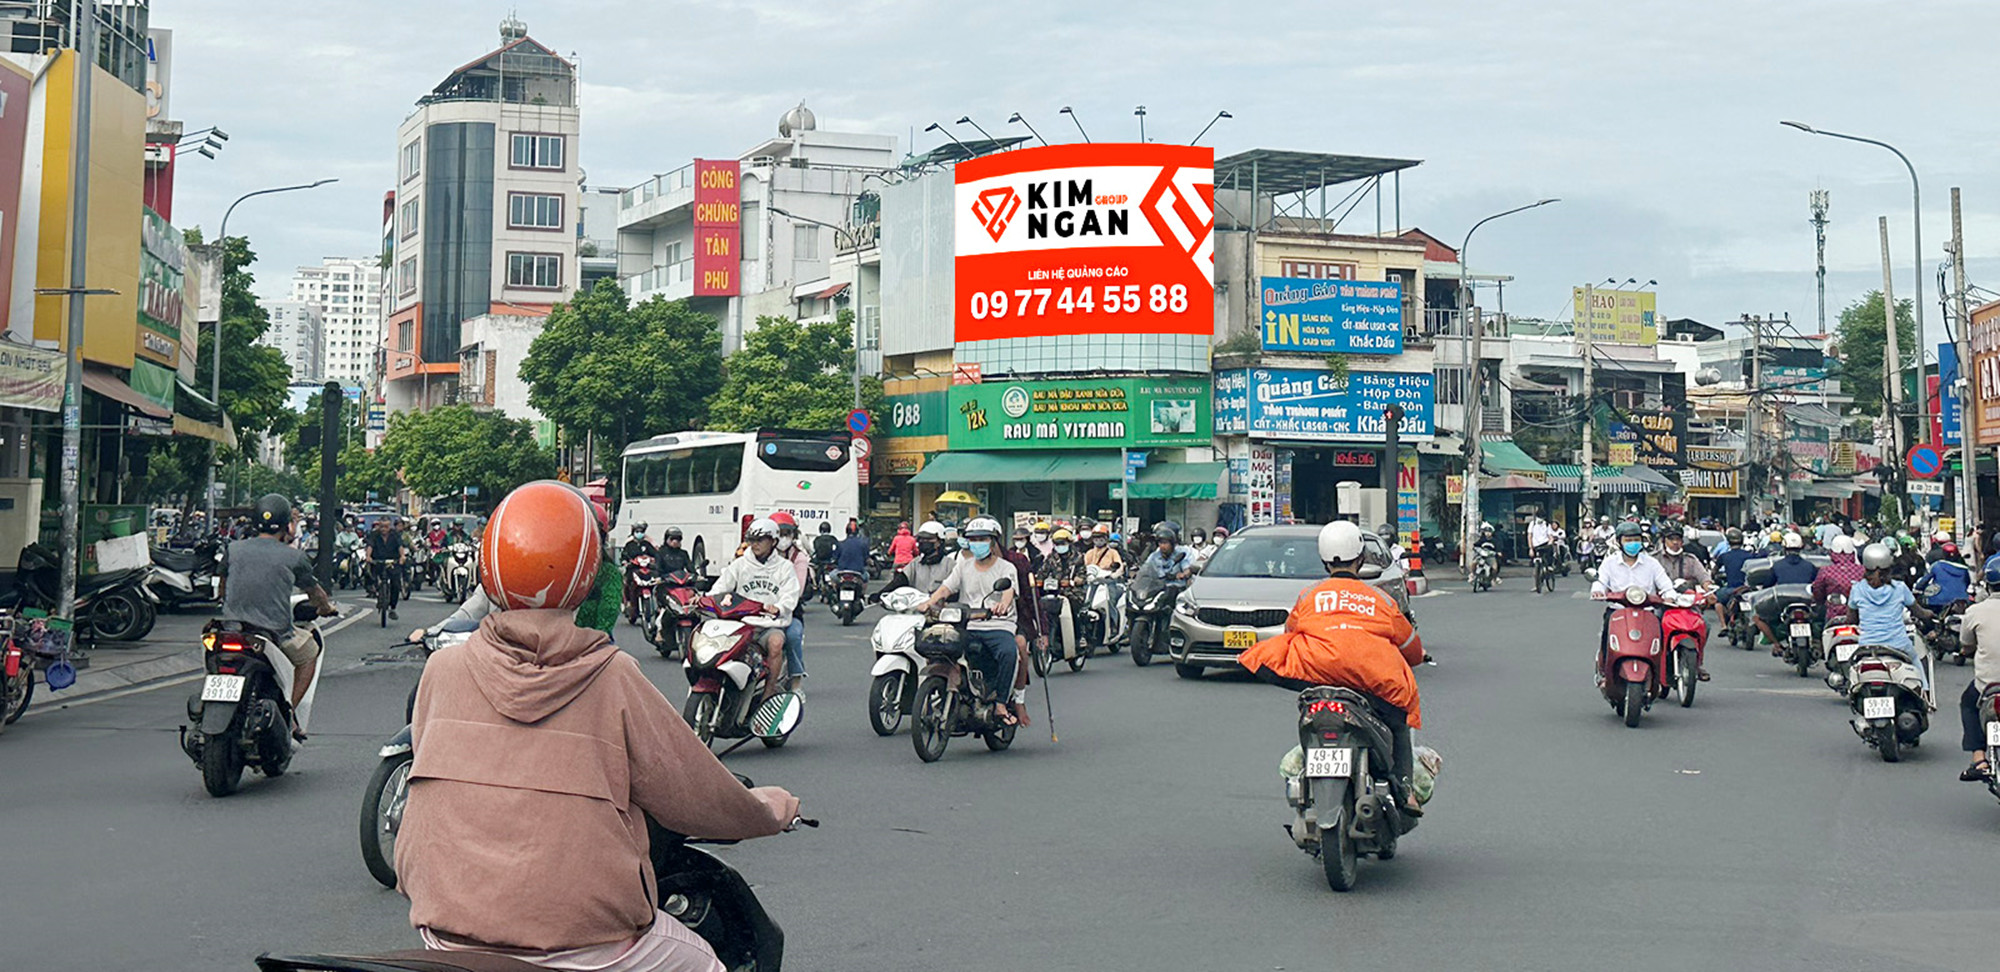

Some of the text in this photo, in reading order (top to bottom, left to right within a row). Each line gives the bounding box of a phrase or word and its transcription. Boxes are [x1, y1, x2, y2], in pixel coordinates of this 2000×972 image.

[701, 165, 735, 189] CÔNG
[1028, 179, 1128, 209] KIM GROUP
[697, 199, 738, 222] CHỨNG
[1028, 209, 1128, 239] NGAN
[705, 233, 729, 256] TÂN
[704, 266, 729, 290] PHÚ
[1028, 265, 1129, 280] LIÊN HỆ QUẢNG CÁO
[971, 283, 1188, 319] 09 77 44 55 88
[1264, 282, 1338, 306] Quảng Cáo
[1349, 333, 1395, 348] Khắc Dấu
[1257, 377, 1313, 402] Quảng
[1363, 375, 1395, 388] Bảng
[1399, 376, 1429, 388] Hiệu
[1363, 388, 1390, 400] Hộp
[1263, 404, 1283, 416] TÂN
[1321, 405, 1347, 418] PHÁT
[967, 410, 987, 430] 12K
[1003, 418, 1125, 438] RAU MÁ VITAMIN
[1357, 413, 1386, 432] Khắ
[1252, 446, 1272, 460] Dấu
[1251, 461, 1273, 474] Mộc
[1713, 471, 1733, 488] TAY
[778, 508, 829, 519] B-108.71
[742, 580, 780, 595] DENVER
[1339, 589, 1376, 604] Shopee
[1339, 599, 1376, 616] Food
[205, 688, 238, 699] 391.04
[1313, 749, 1344, 761] 49-K1
[1309, 762, 1349, 774] 389.70
